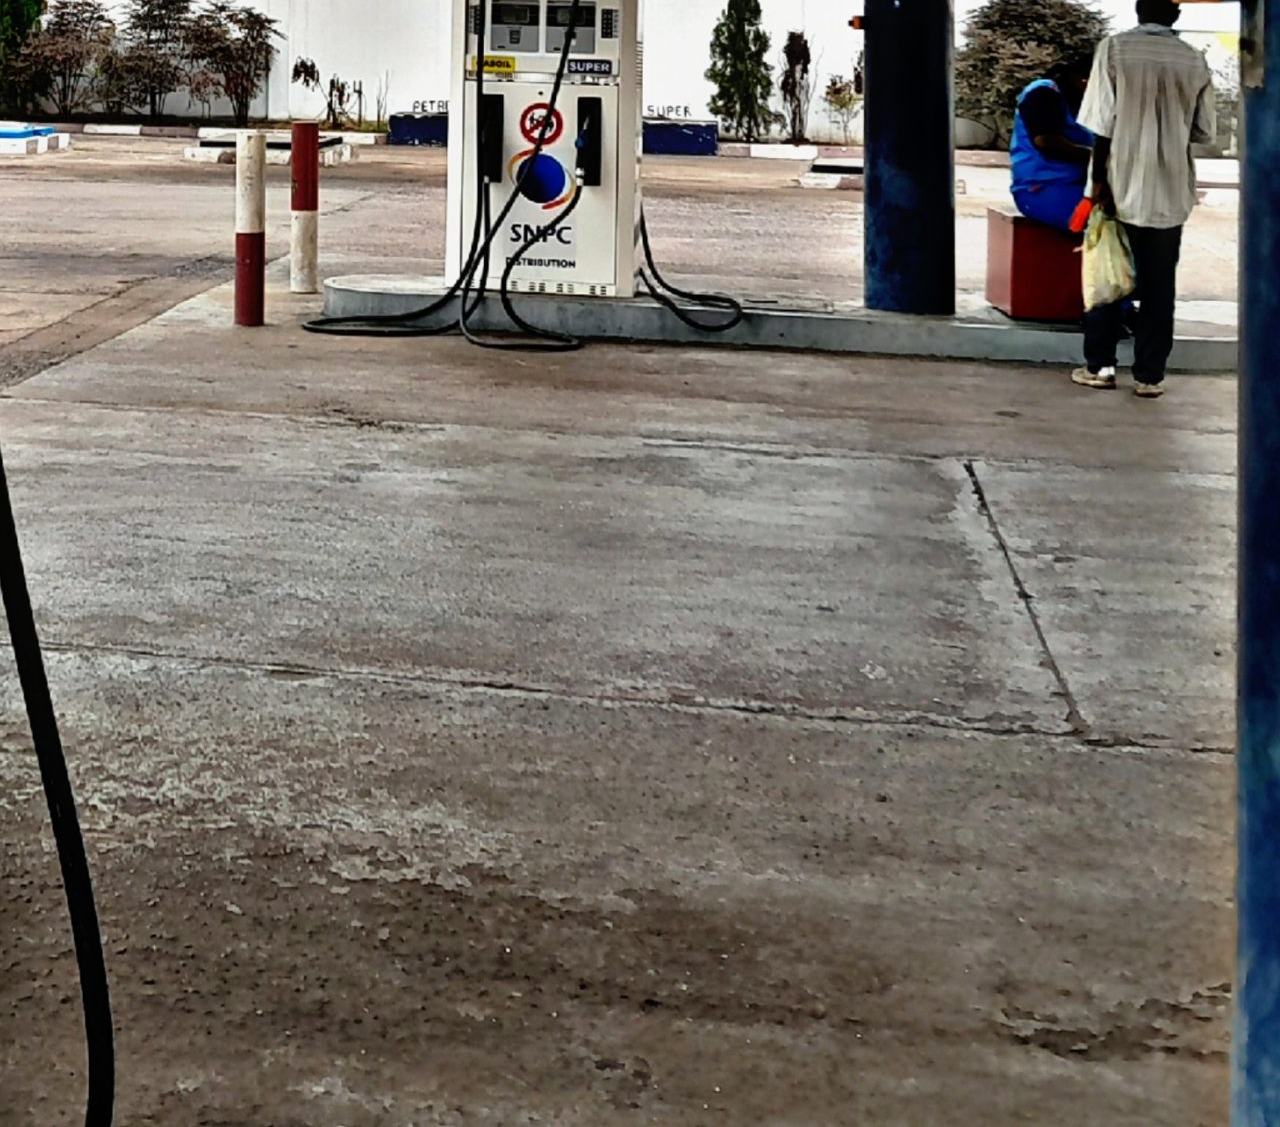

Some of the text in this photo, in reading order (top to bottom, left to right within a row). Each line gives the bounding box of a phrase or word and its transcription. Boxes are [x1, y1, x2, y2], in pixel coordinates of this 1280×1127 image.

[476, 60, 511, 69] ASOIL
[569, 61, 610, 72] SUPER
[647, 105, 692, 117] SUPER
[510, 224, 572, 245] SNPC
